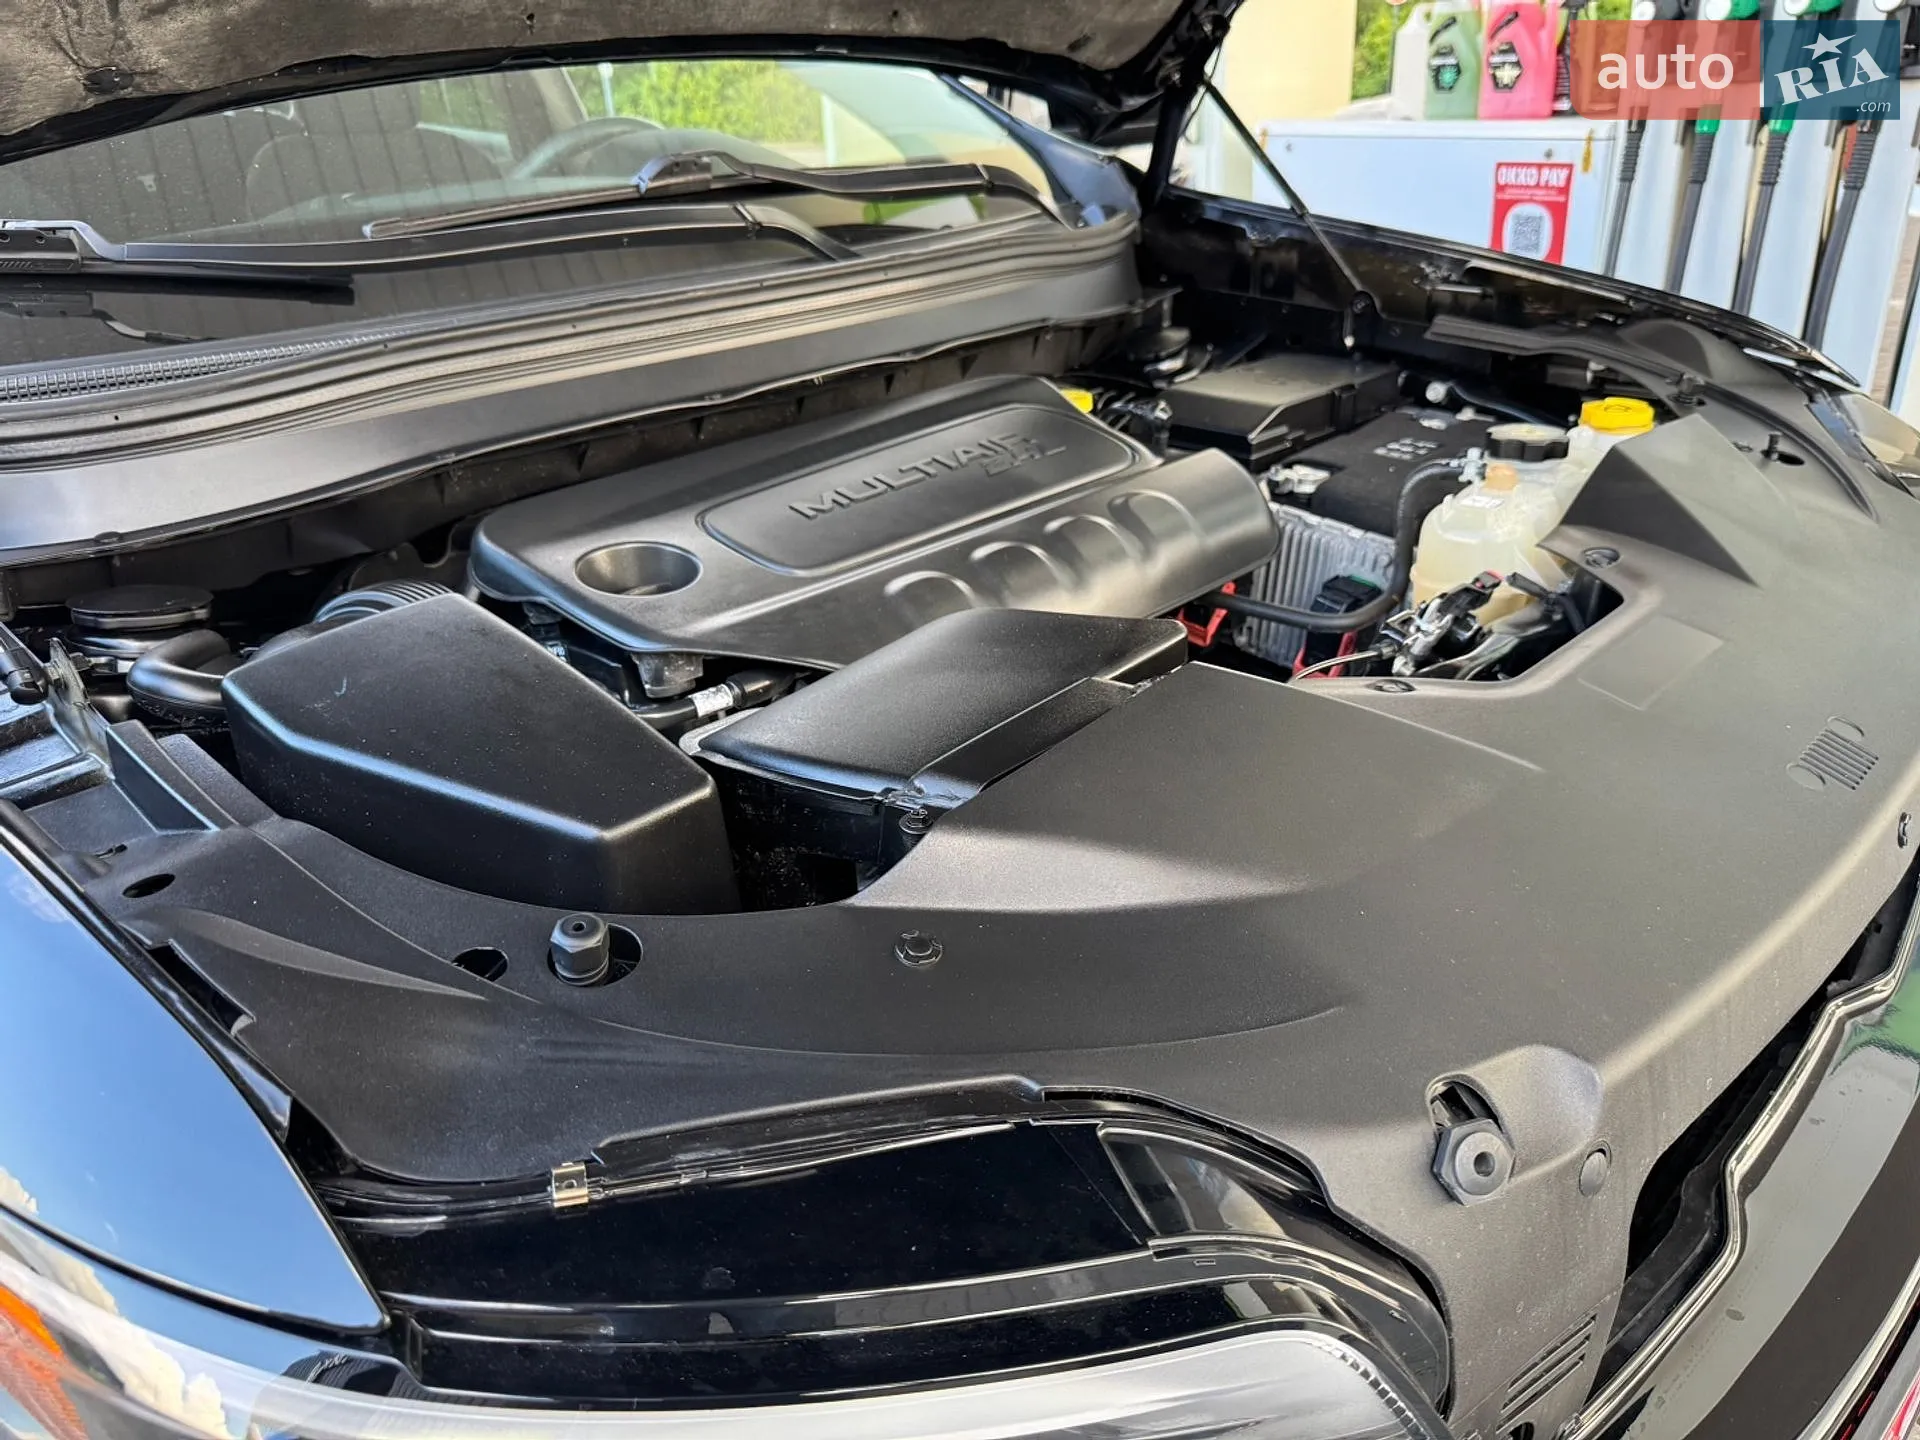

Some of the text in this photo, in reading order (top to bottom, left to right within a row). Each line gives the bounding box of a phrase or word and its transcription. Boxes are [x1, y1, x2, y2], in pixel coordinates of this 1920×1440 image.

[1497, 165, 1571, 189] OKKO PAY
[788, 433, 1034, 520] MULTIAIR
